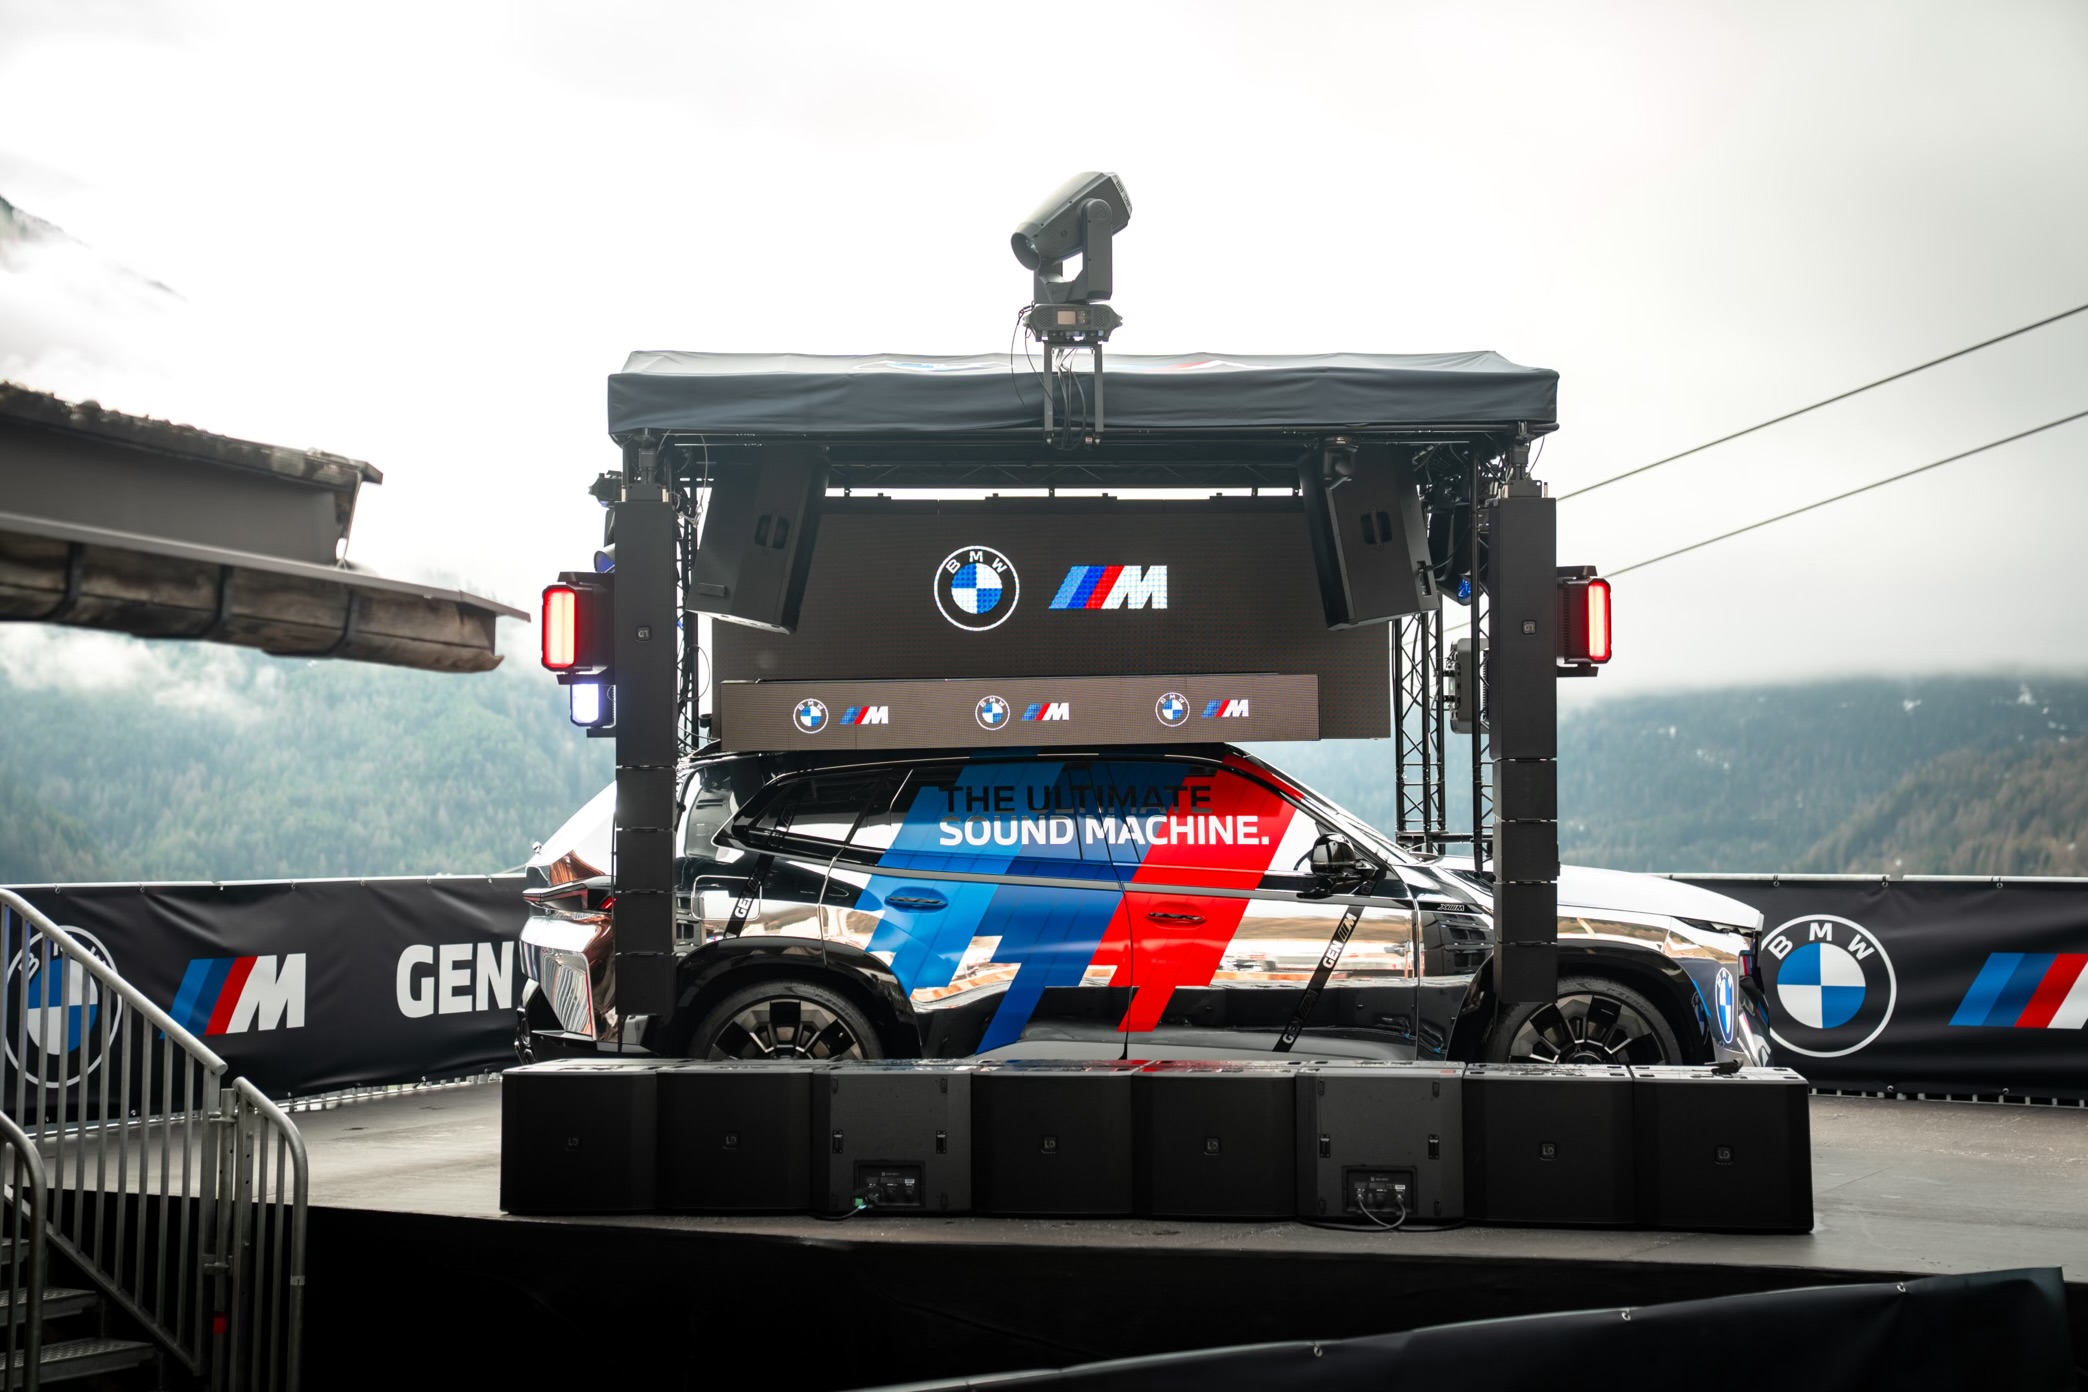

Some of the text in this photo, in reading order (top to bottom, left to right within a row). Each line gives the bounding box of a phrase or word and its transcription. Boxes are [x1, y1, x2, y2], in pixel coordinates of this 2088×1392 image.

[945, 550, 1008, 574] BMW
[939, 785, 1213, 814] THE ULTIMATE
[939, 814, 1270, 846] SOUND MACHINE.
[1322, 940, 1344, 969] GEN
[1767, 921, 1875, 961] BMW
[396, 940, 515, 1019] GEN
